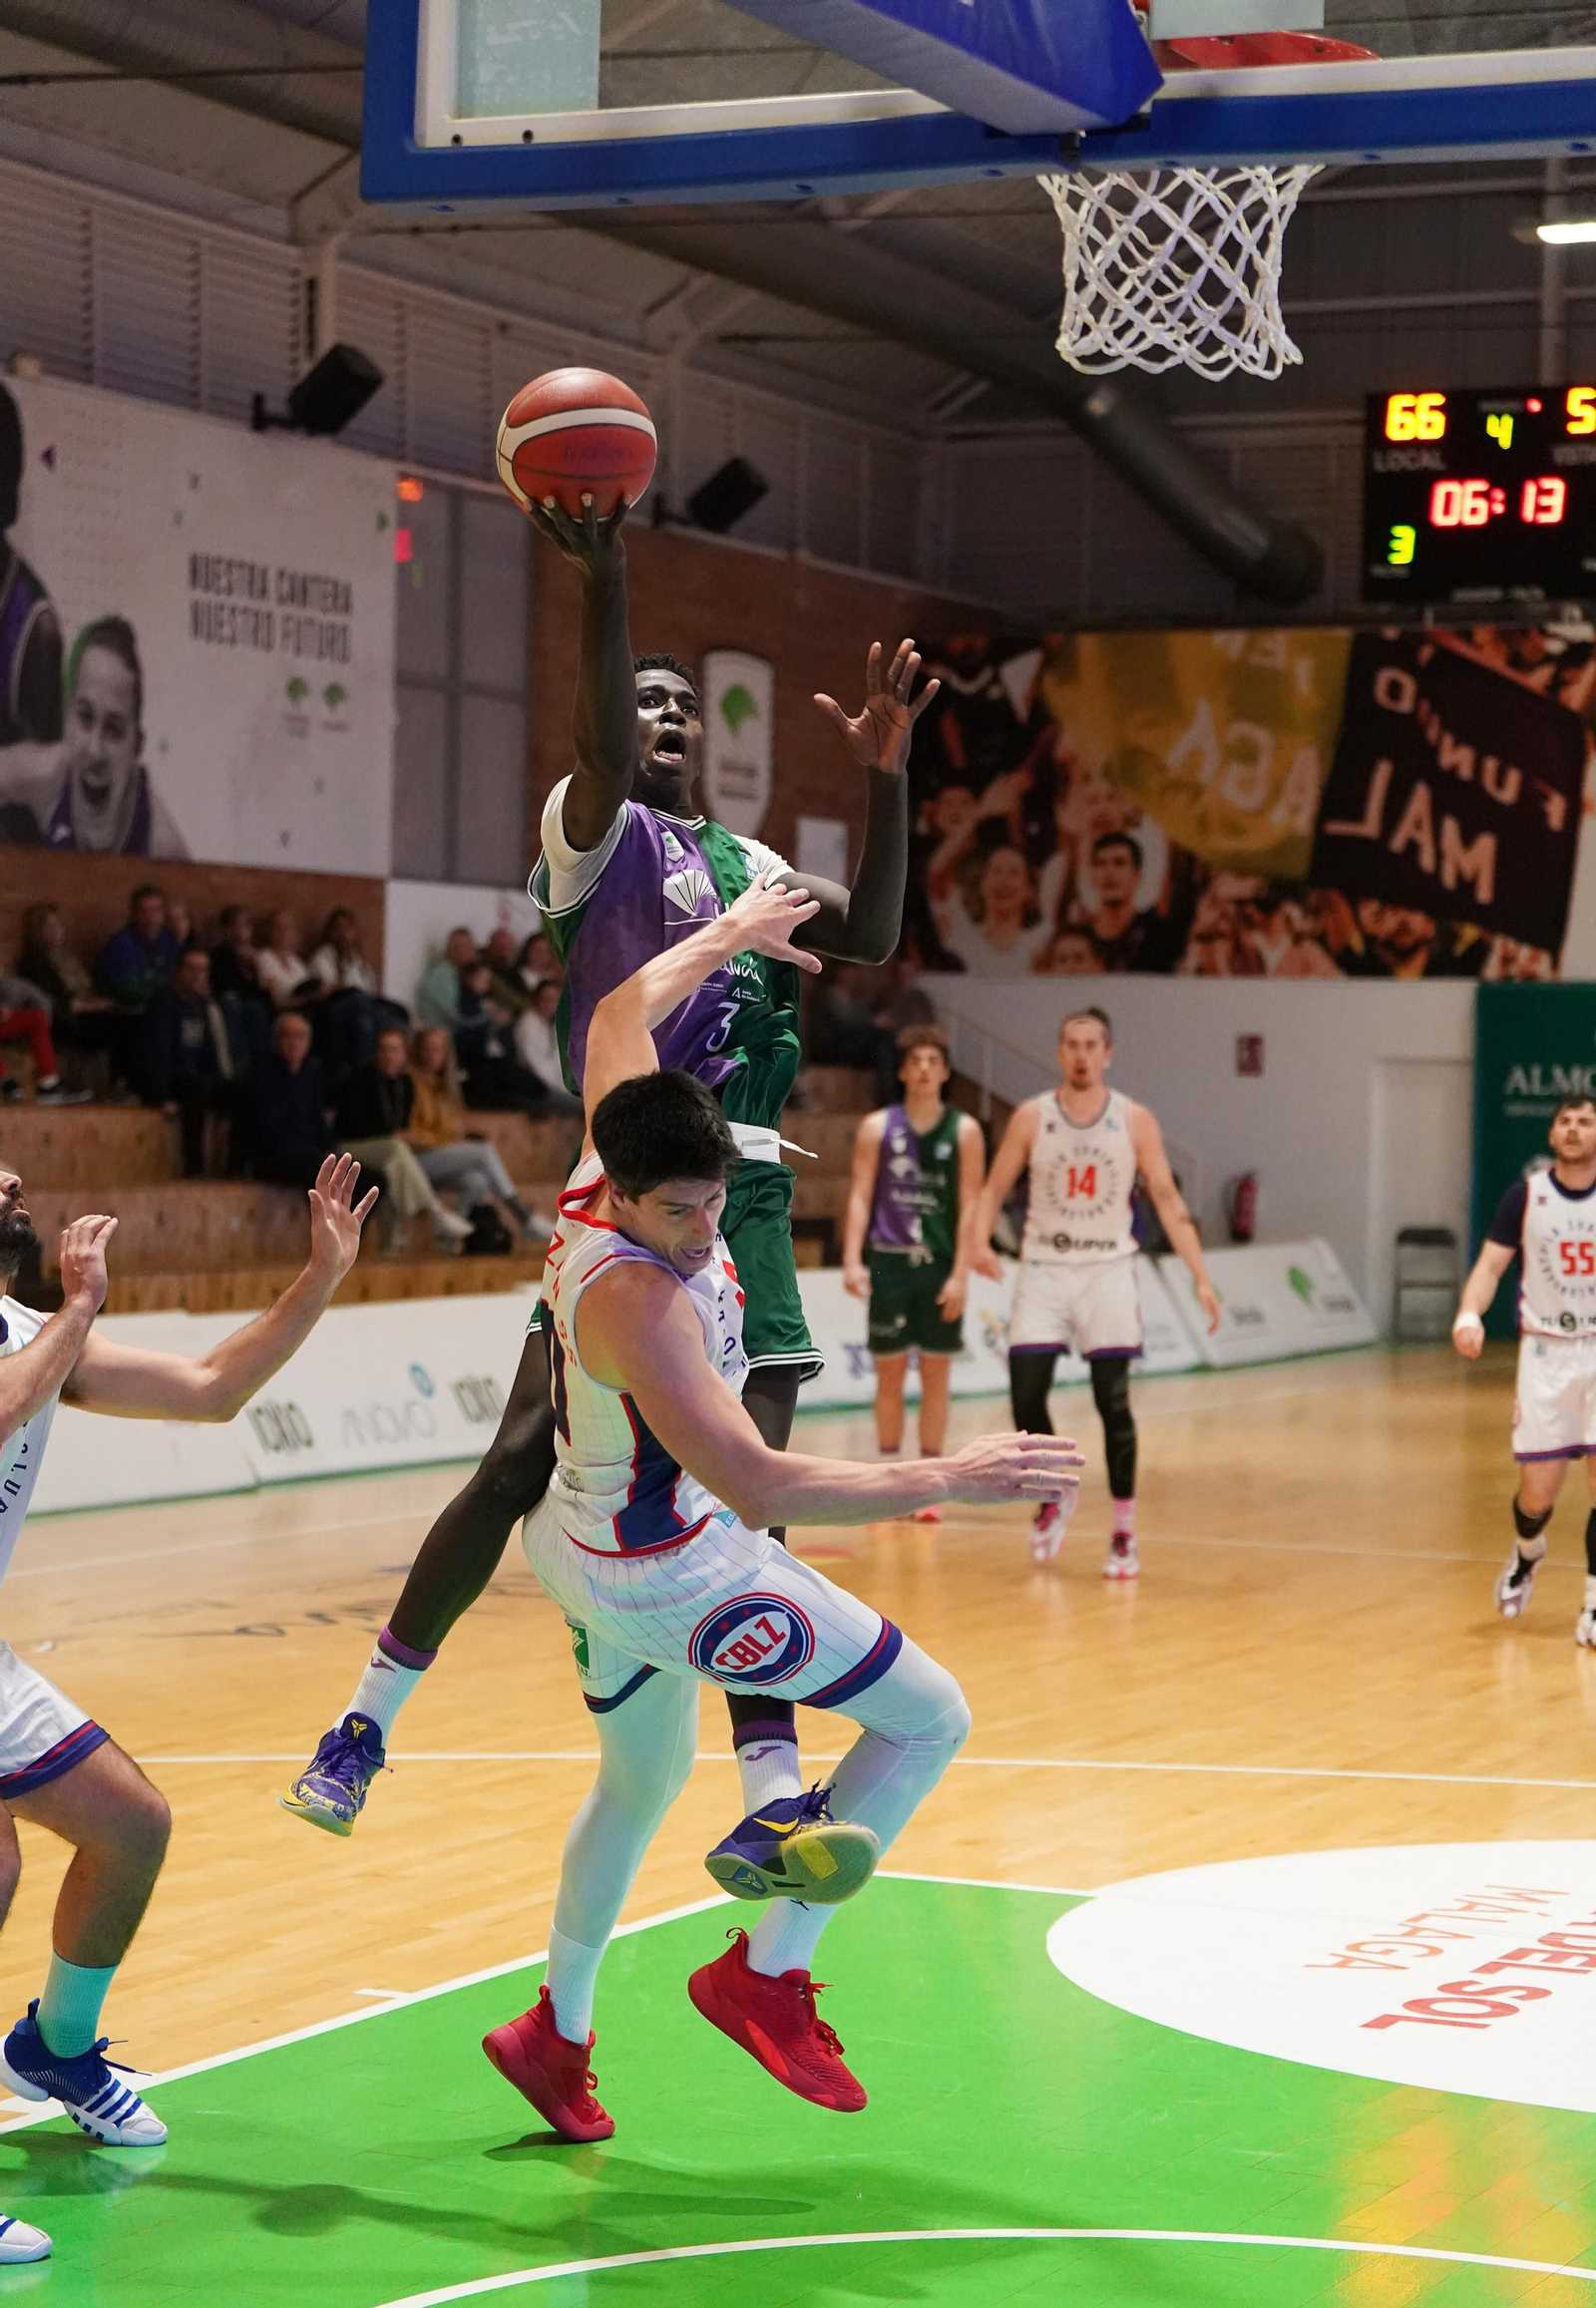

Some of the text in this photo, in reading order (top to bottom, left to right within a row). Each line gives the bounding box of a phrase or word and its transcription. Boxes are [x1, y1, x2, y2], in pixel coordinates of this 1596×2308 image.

[1386, 393, 1446, 441] 66
[1485, 413, 1514, 450] 4
[1429, 476, 1566, 528] 06:13
[1387, 525, 1416, 565] 3
[190, 553, 352, 616] NUESTRA CANTERA
[190, 599, 349, 664] NUESTRO FUTURO
[706, 1001, 740, 1052] 3
[1067, 1165, 1096, 1200] 14
[1559, 1241, 1595, 1277] 55
[715, 1616, 787, 1672] CBLZ
